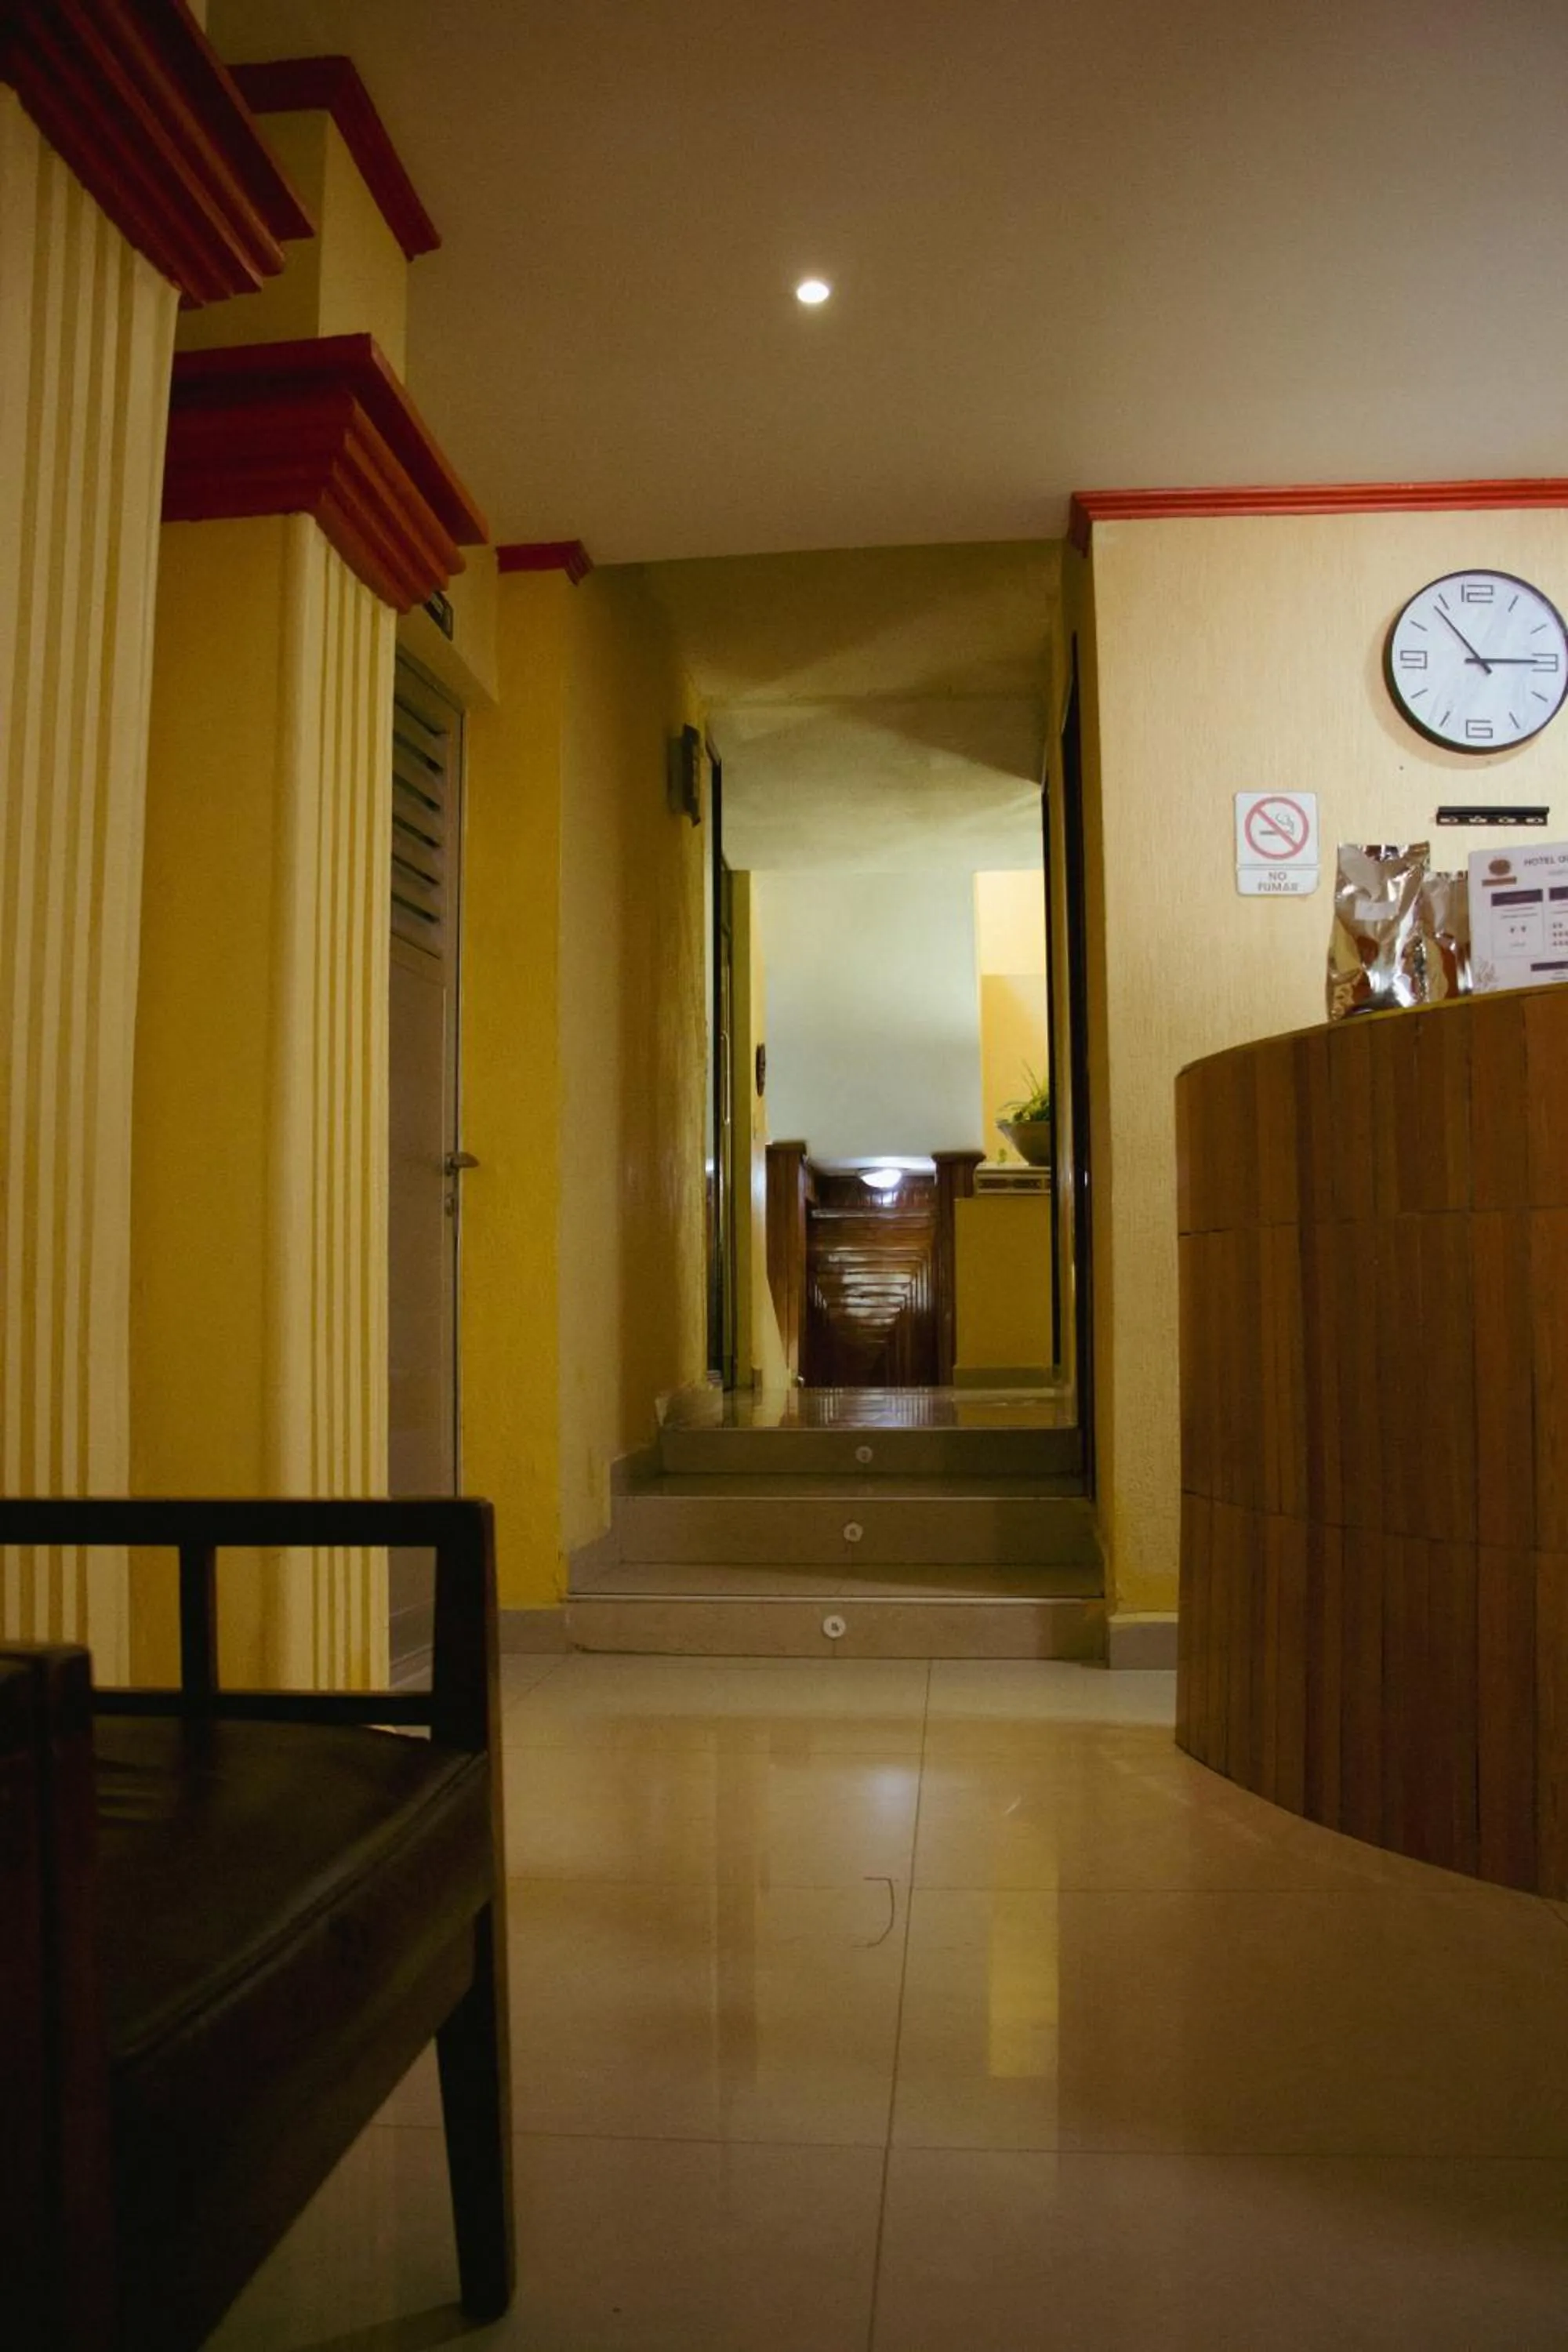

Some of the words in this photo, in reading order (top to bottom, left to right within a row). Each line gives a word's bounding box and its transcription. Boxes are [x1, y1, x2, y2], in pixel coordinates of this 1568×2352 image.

[1461, 584, 1494, 603] 12
[1400, 651, 1427, 669] 9
[1531, 653, 1559, 672] 3
[1465, 719, 1493, 739] 6
[1523, 855, 1556, 866] HOTEL
[1268, 871, 1287, 881] NO
[1258, 882, 1298, 891] FUMAR
